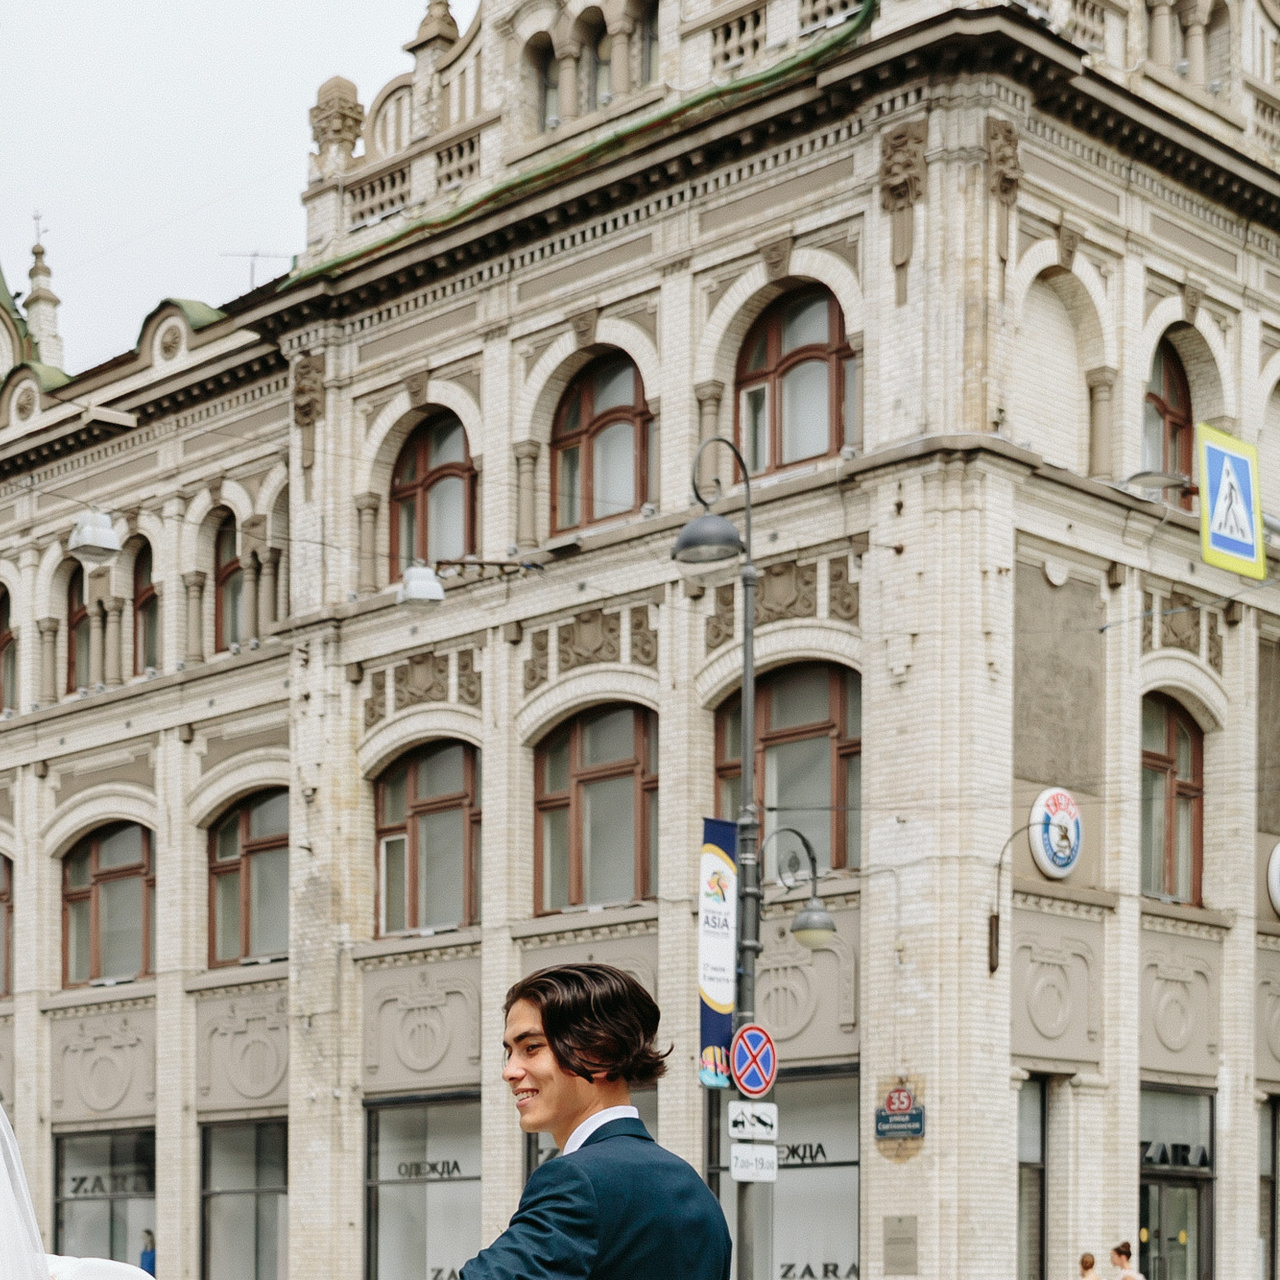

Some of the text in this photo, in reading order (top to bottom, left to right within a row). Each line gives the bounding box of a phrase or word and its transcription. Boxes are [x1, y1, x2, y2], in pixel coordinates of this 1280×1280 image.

[703, 915, 730, 930] ASIA
[890, 1091, 909, 1110] 35
[1139, 1141, 1209, 1167] ZARA
[397, 1160, 462, 1178] ОДЕЖДА
[780, 1263, 858, 1280] ZARA
